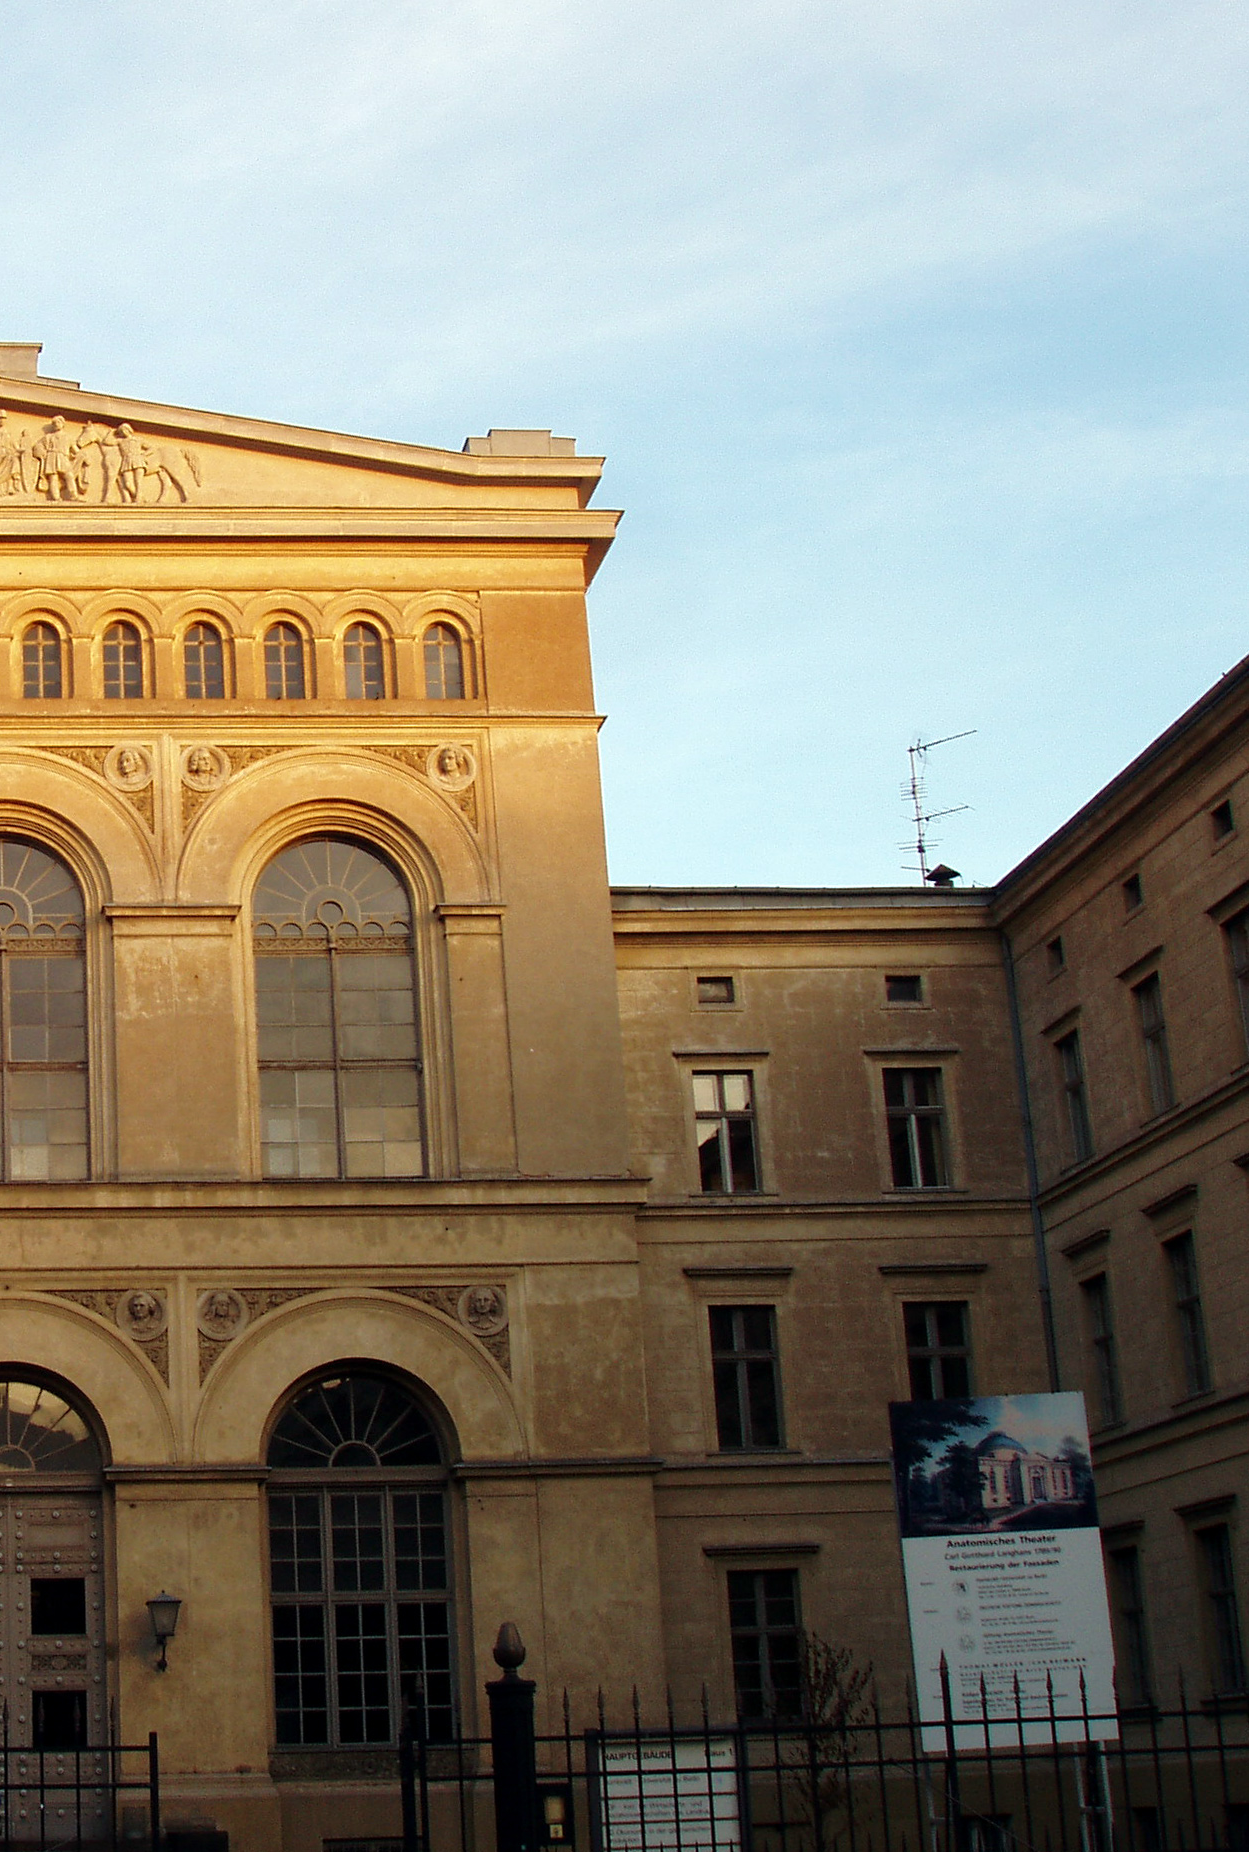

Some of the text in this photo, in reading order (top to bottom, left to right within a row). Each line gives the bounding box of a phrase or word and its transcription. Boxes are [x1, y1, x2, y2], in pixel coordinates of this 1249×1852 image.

[946, 1534, 1057, 1549] Anatomisches Theater
[944, 1552, 960, 1561] Carl
[997, 1548, 1032, 1558] Langhans
[948, 1558, 1060, 1572] Restaurierung der Fassaden
